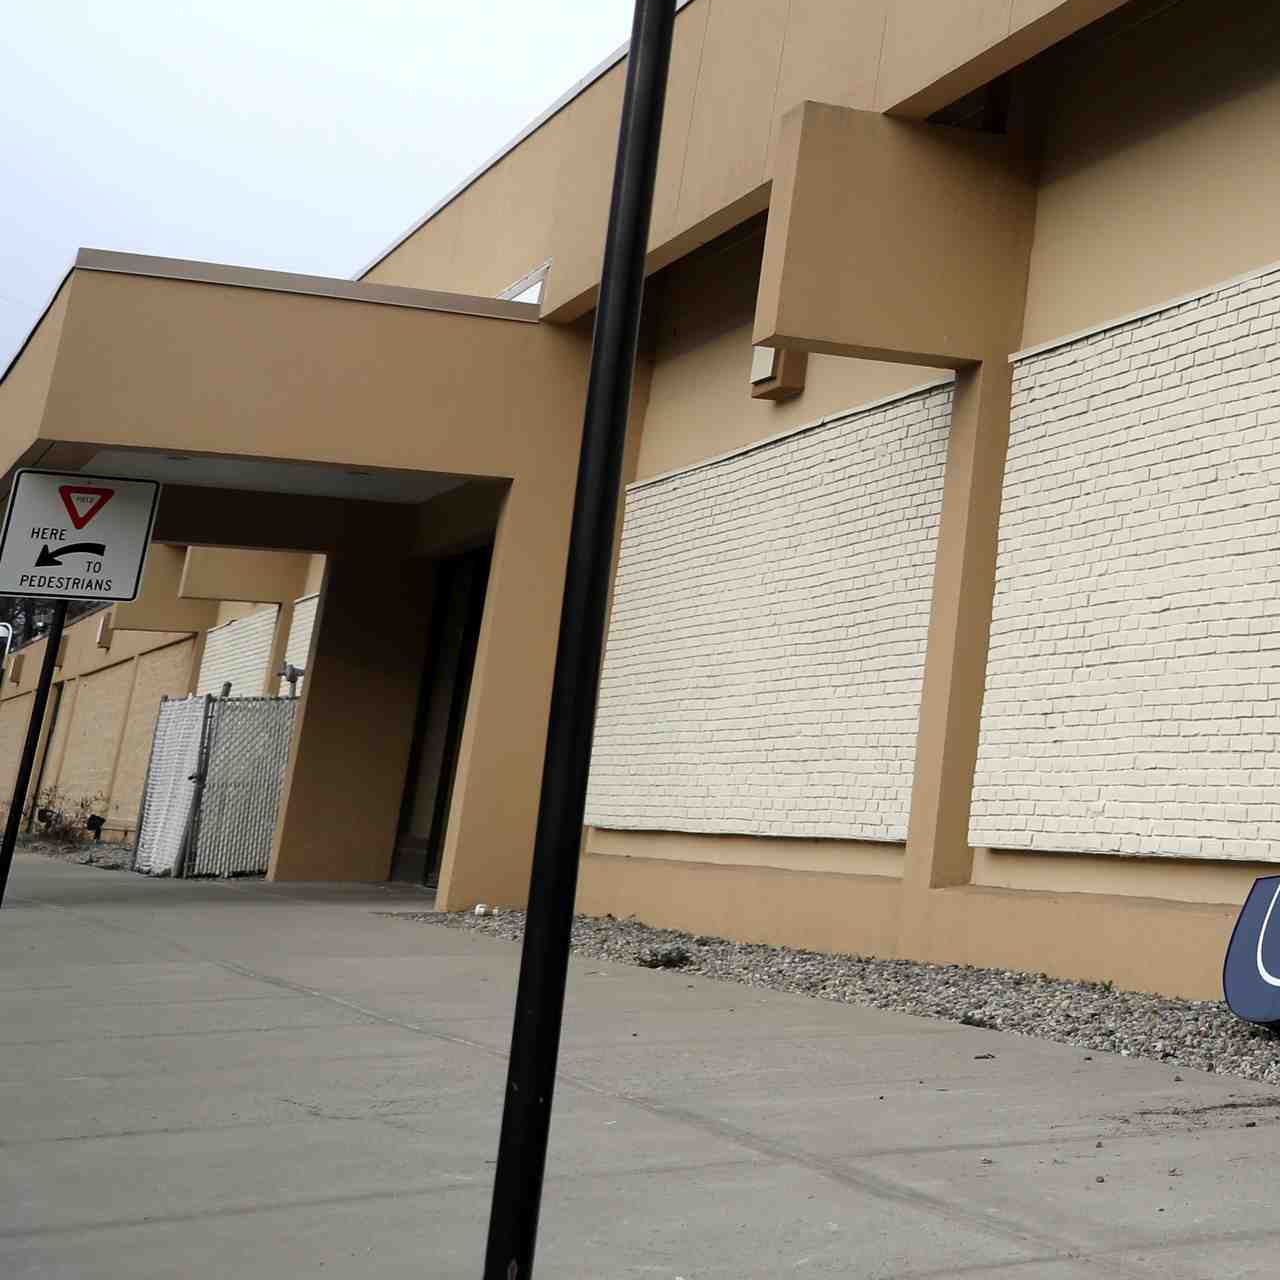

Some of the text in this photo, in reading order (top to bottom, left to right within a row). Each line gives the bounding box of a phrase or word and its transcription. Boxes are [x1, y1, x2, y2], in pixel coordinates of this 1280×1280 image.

[31, 527, 68, 541] HERE
[86, 561, 102, 574] TO
[19, 575, 113, 592] PEDESTRIANS
